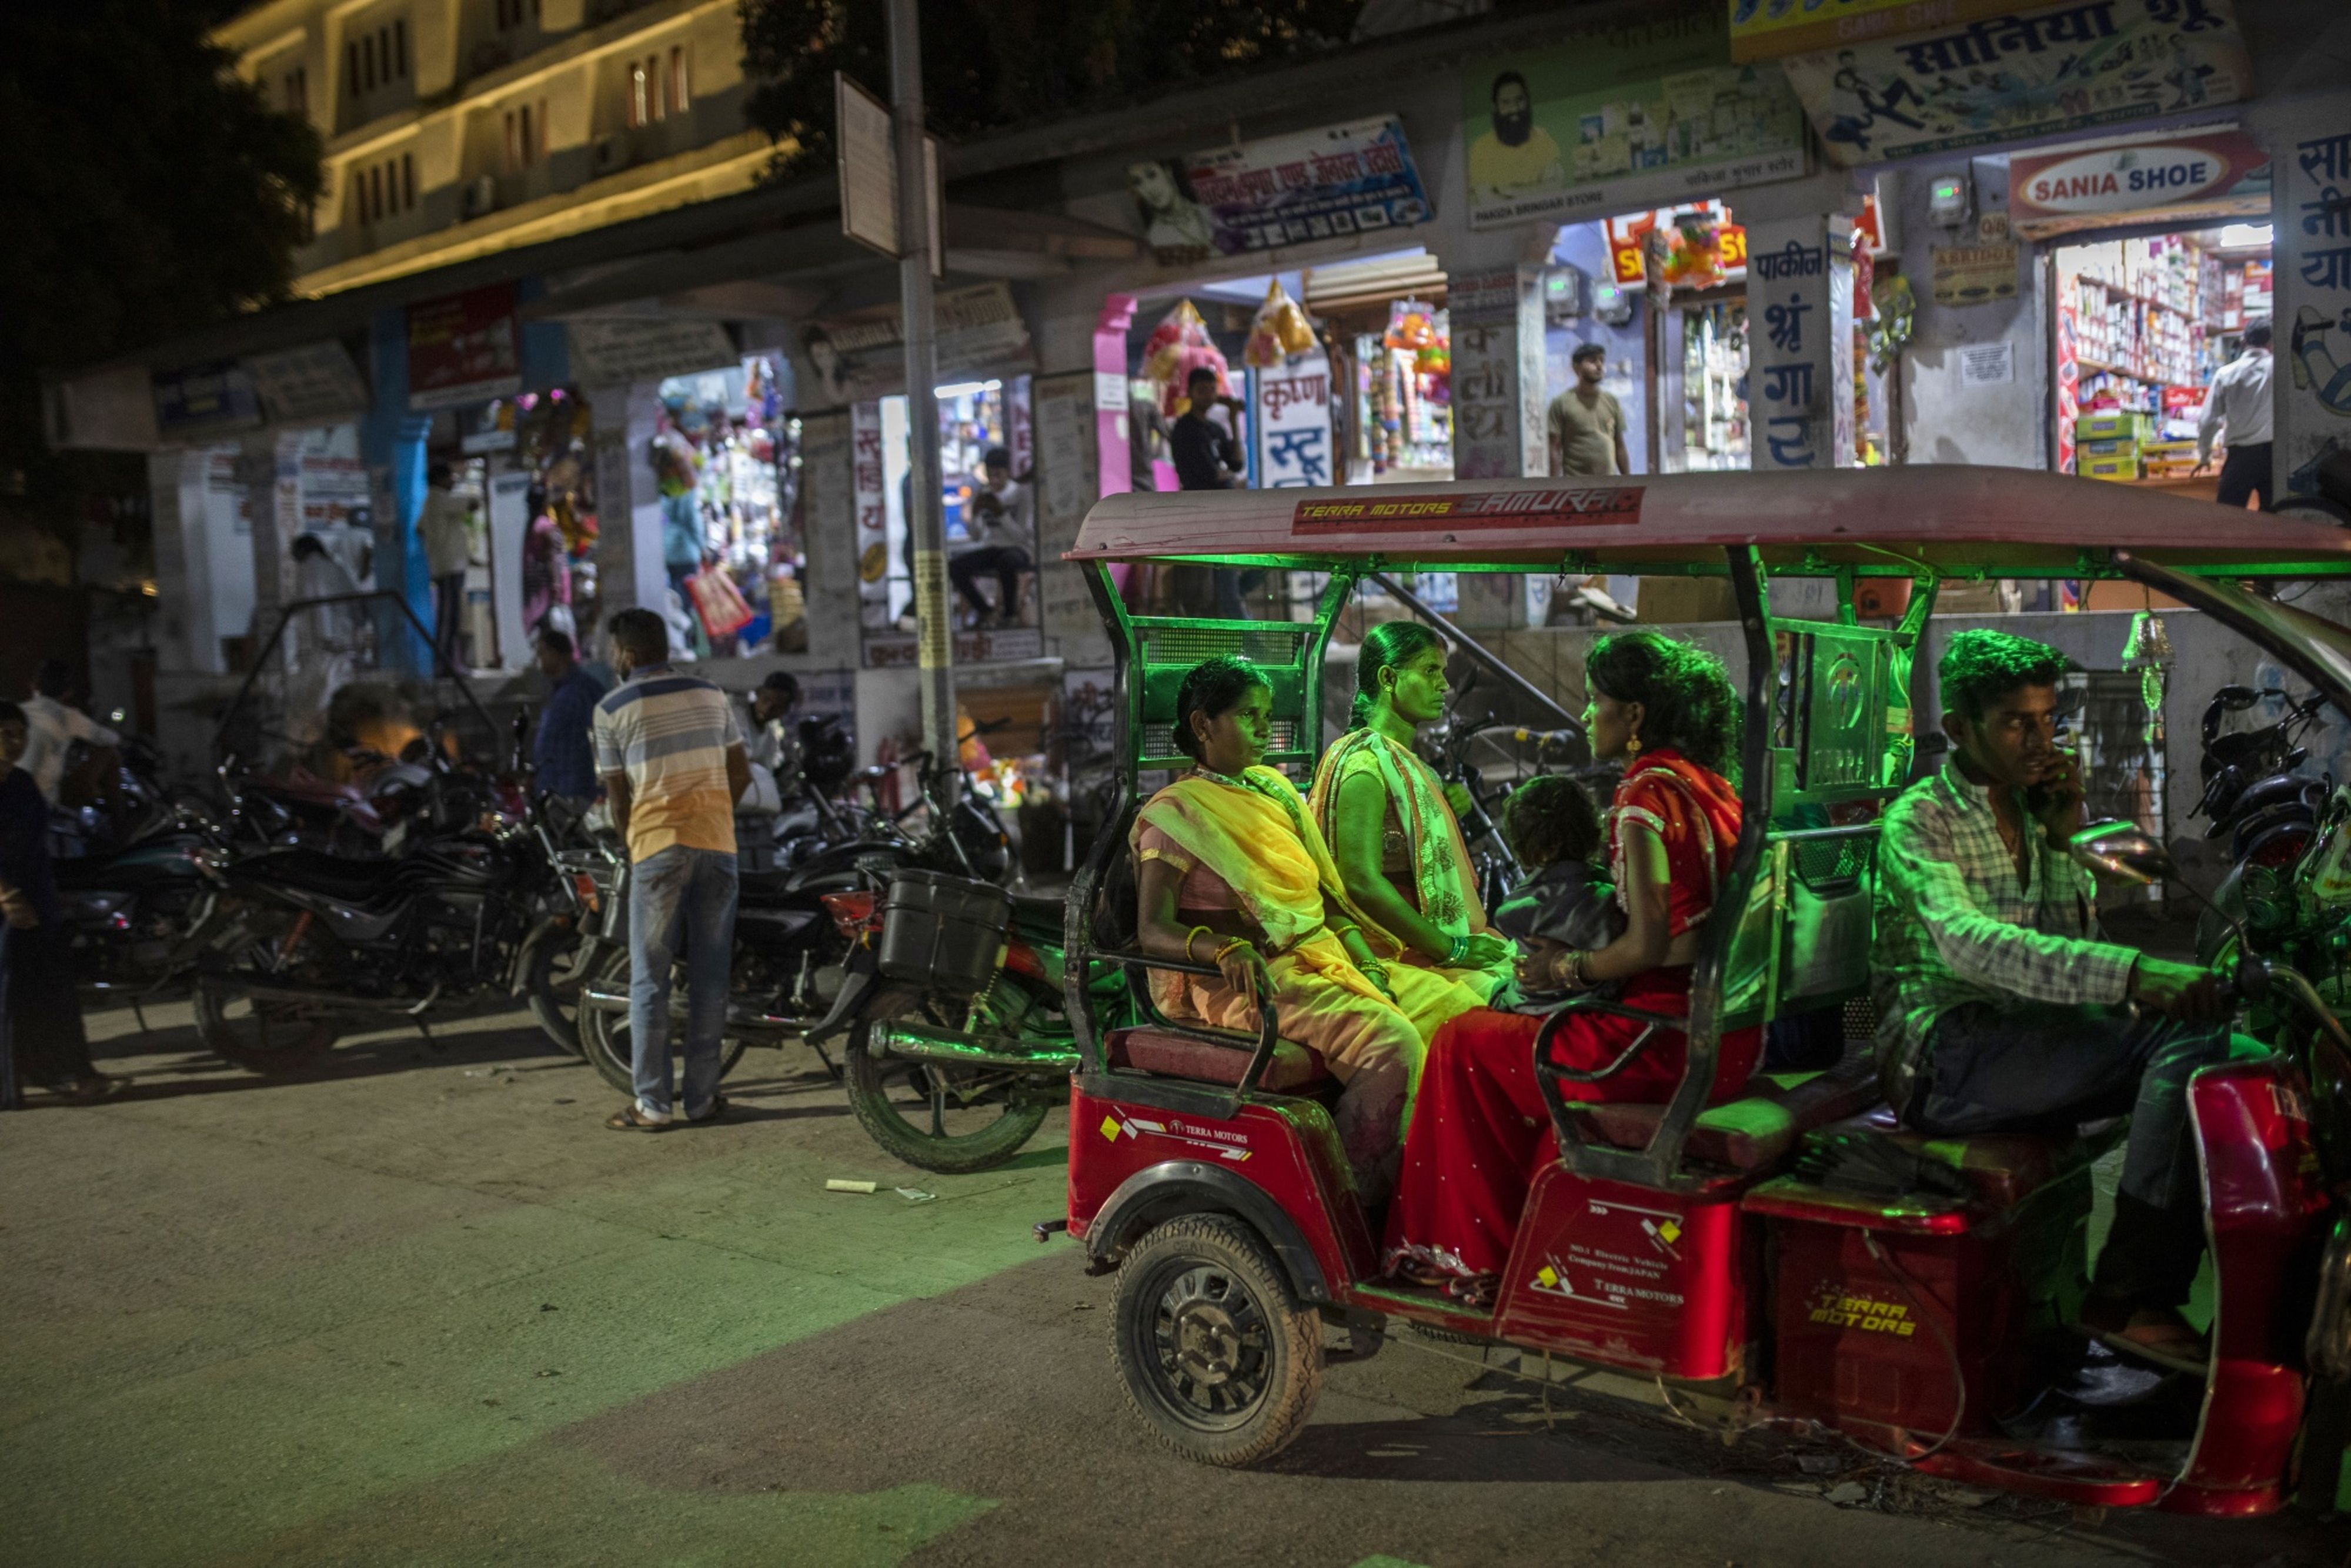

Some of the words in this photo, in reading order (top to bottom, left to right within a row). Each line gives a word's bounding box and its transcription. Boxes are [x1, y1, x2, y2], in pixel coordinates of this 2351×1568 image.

[2035, 173, 2120, 202] SANIA
[2129, 162, 2208, 192] SHOE
[1263, 374, 1326, 421] कृष्णा
[1302, 505, 1365, 518] TERRA
[1370, 502, 1453, 515] MOTORS
[1185, 1125, 1212, 1138] TERRA
[1214, 1129, 1248, 1144] MOTORS
[1568, 1253, 1606, 1270] Company
[1594, 1249, 1629, 1263] Electric
[1634, 1256, 1669, 1271] Vehicle
[1594, 1278, 1634, 1296] TERRA
[1635, 1289, 1684, 1305] MOTORS
[1822, 1295, 1909, 1319] TERRA
[1809, 1308, 1917, 1336] MOTORS
